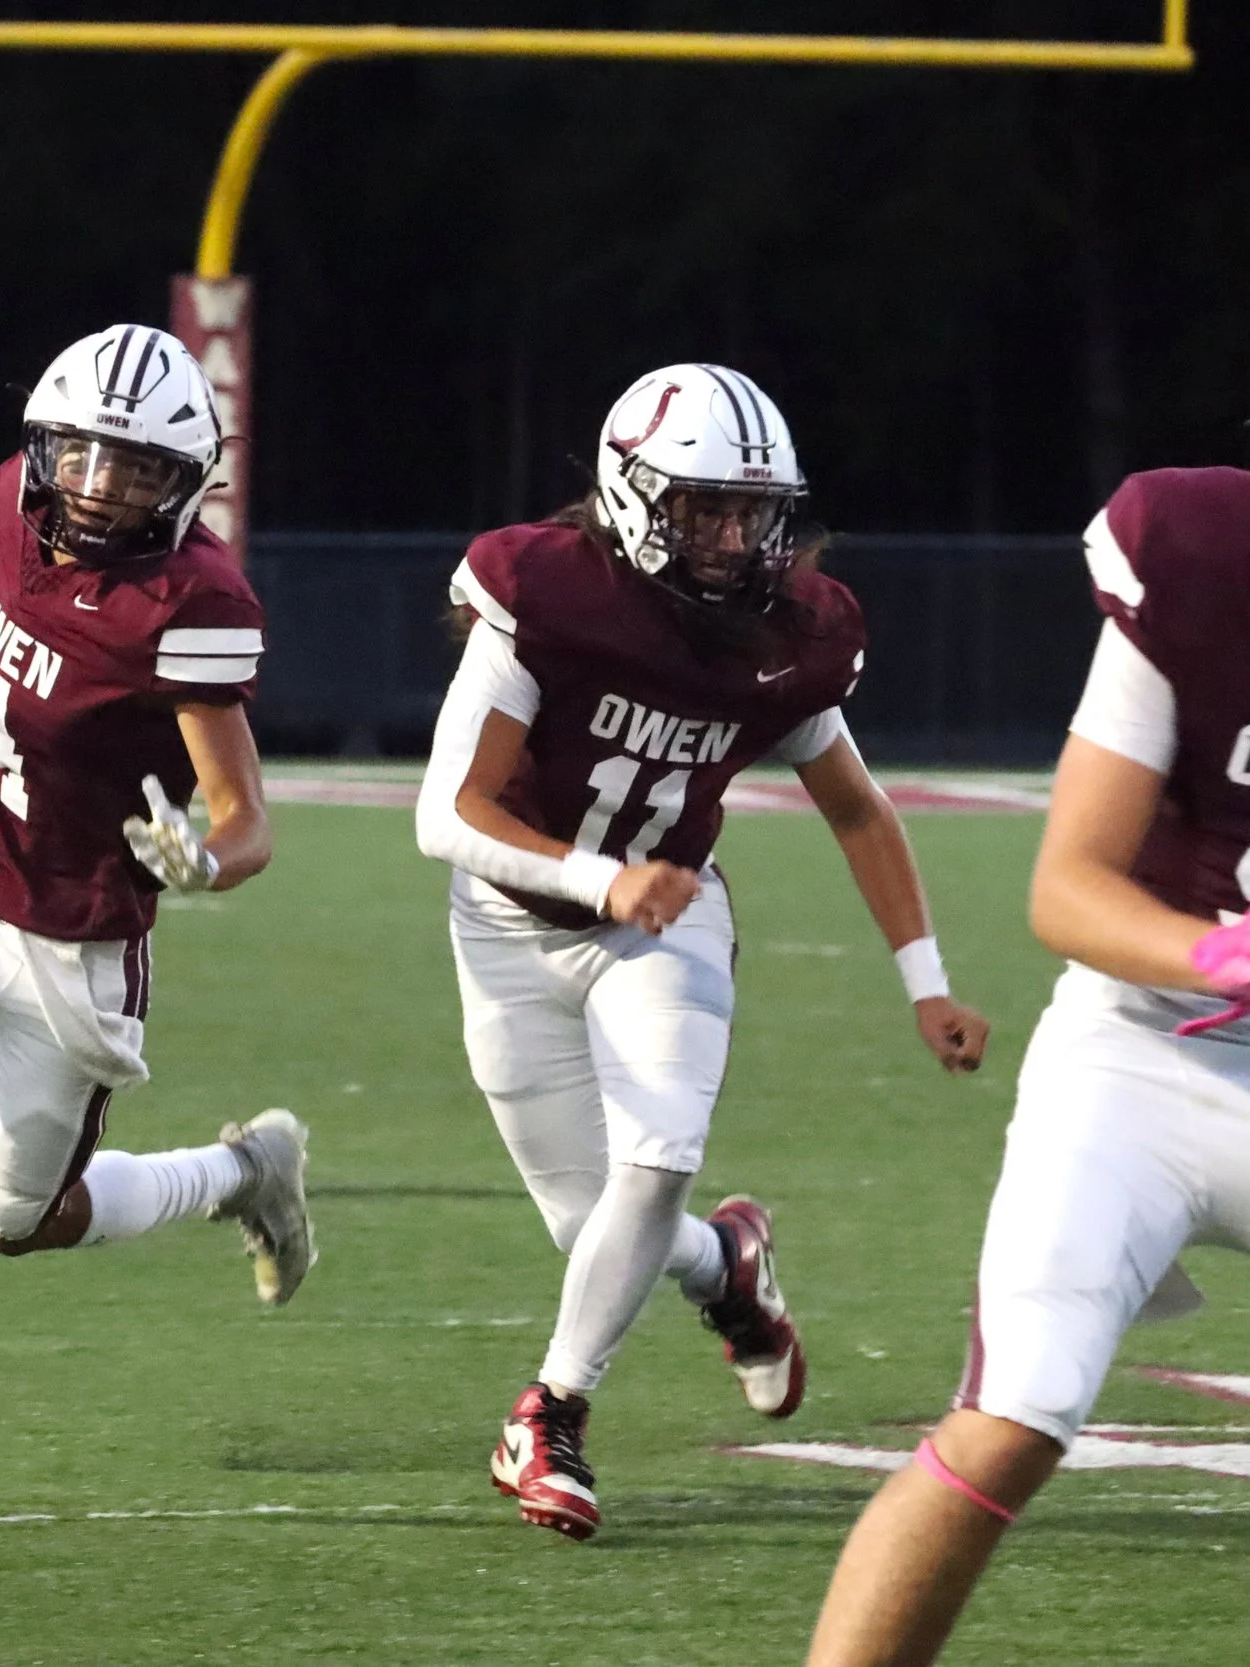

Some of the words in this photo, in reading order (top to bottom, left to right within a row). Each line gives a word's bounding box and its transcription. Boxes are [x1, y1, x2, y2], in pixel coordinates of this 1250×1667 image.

[96, 413, 130, 429] OWEN
[589, 693, 742, 764] OWEN
[573, 755, 693, 867] 11
